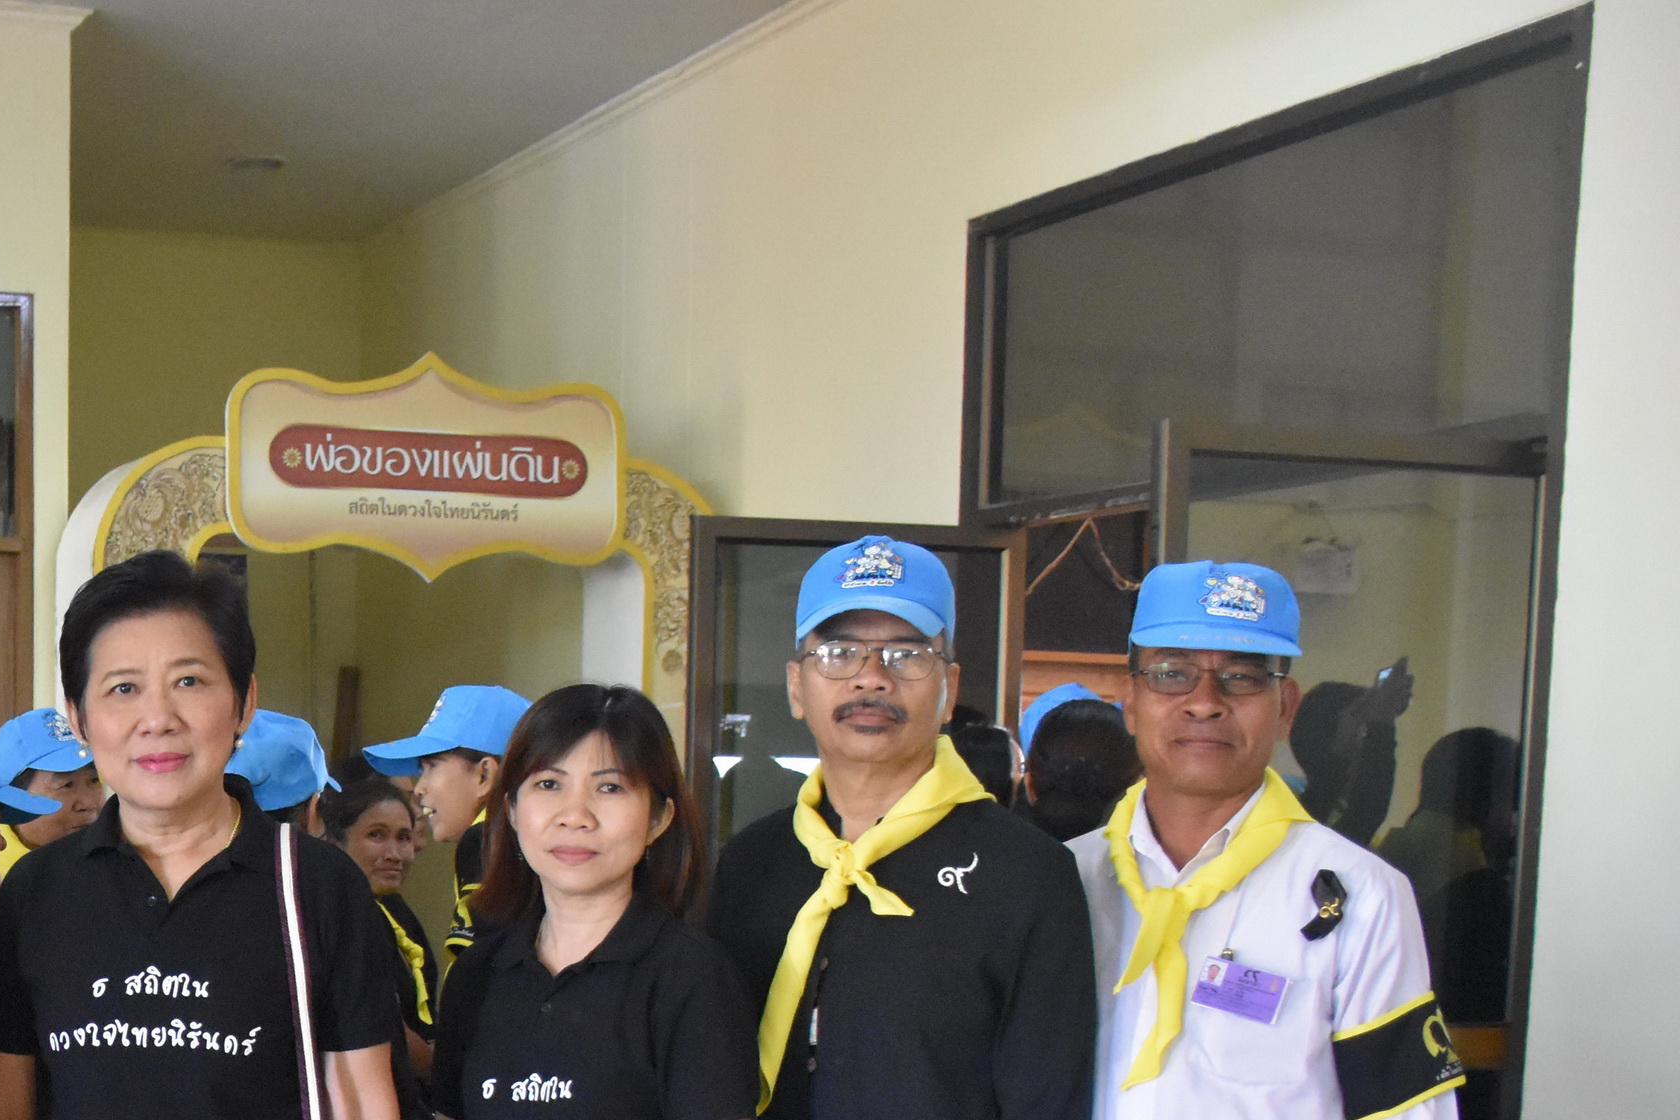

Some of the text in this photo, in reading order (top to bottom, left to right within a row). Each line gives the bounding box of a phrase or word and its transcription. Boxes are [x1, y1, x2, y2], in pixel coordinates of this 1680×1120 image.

[304, 434, 560, 485] พ่อของแผ่นดิน
[348, 496, 519, 522] สถิตในดวงใจไทยนิรันดร์
[91, 965, 210, 999] ธ สถิตใน
[49, 1018, 262, 1057] ดวงใจไทยนิรันดร์
[481, 1072, 573, 1103] ธ สถิตใน
